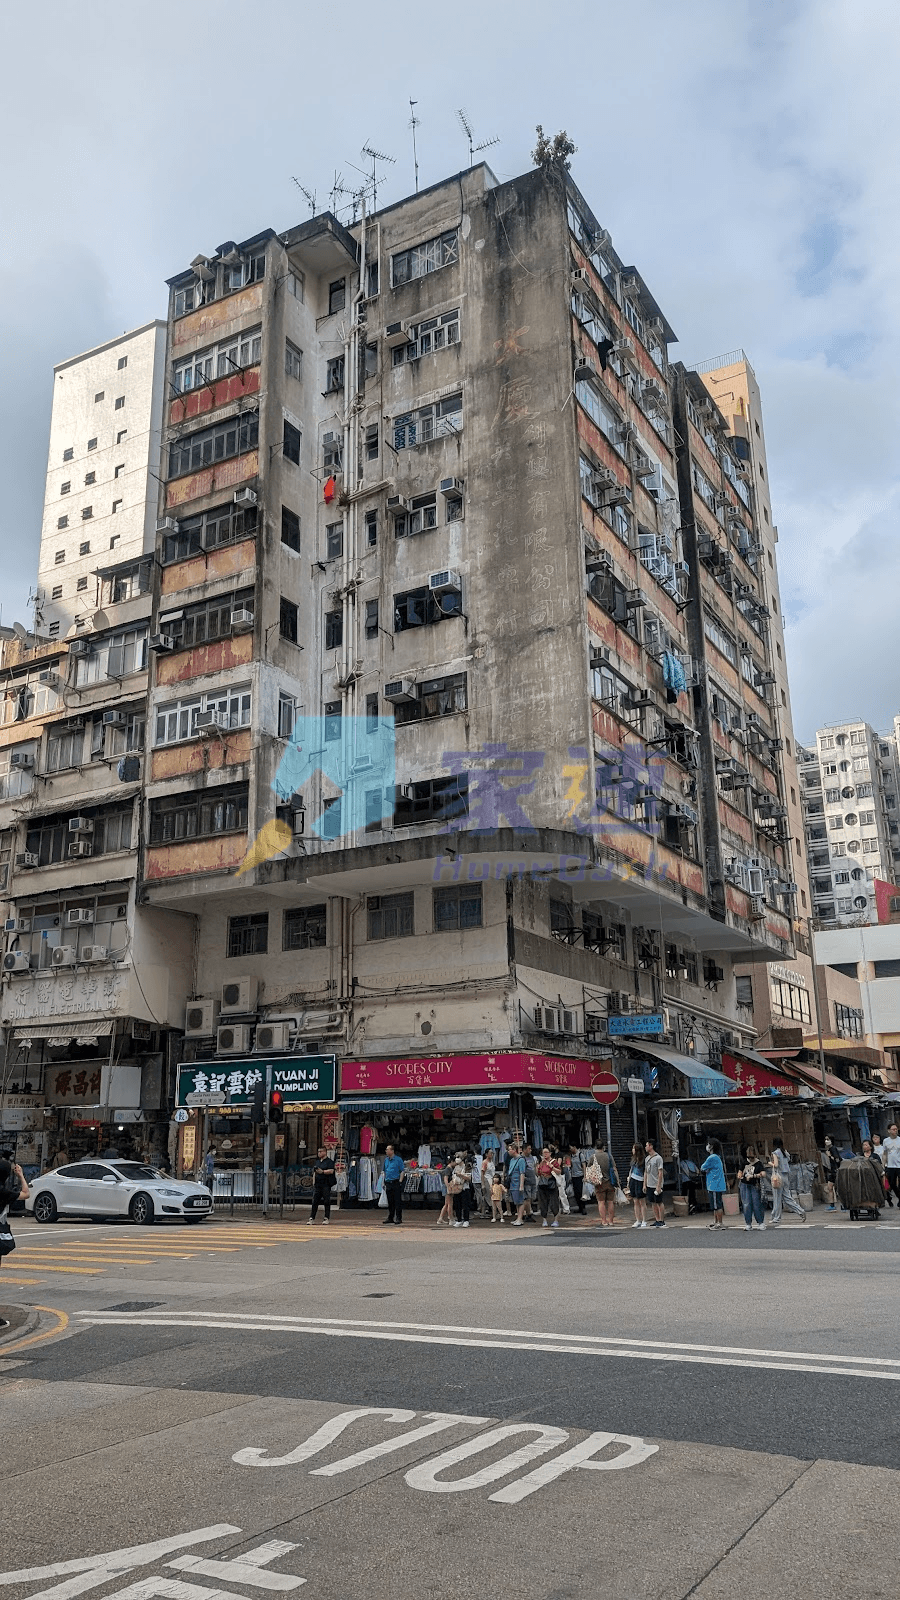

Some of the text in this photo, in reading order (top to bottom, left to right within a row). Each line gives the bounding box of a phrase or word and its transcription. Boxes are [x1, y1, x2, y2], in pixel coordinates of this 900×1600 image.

[50, 1001, 102, 1016] ELECTRICAL
[274, 1069, 319, 1081] YUAN JI
[386, 1062, 452, 1075] STORES CITY
[191, 1068, 263, 1095] 袁記雲餃
[274, 1082, 319, 1091] DUMPLING
[232, 1408, 660, 1503] STOP
